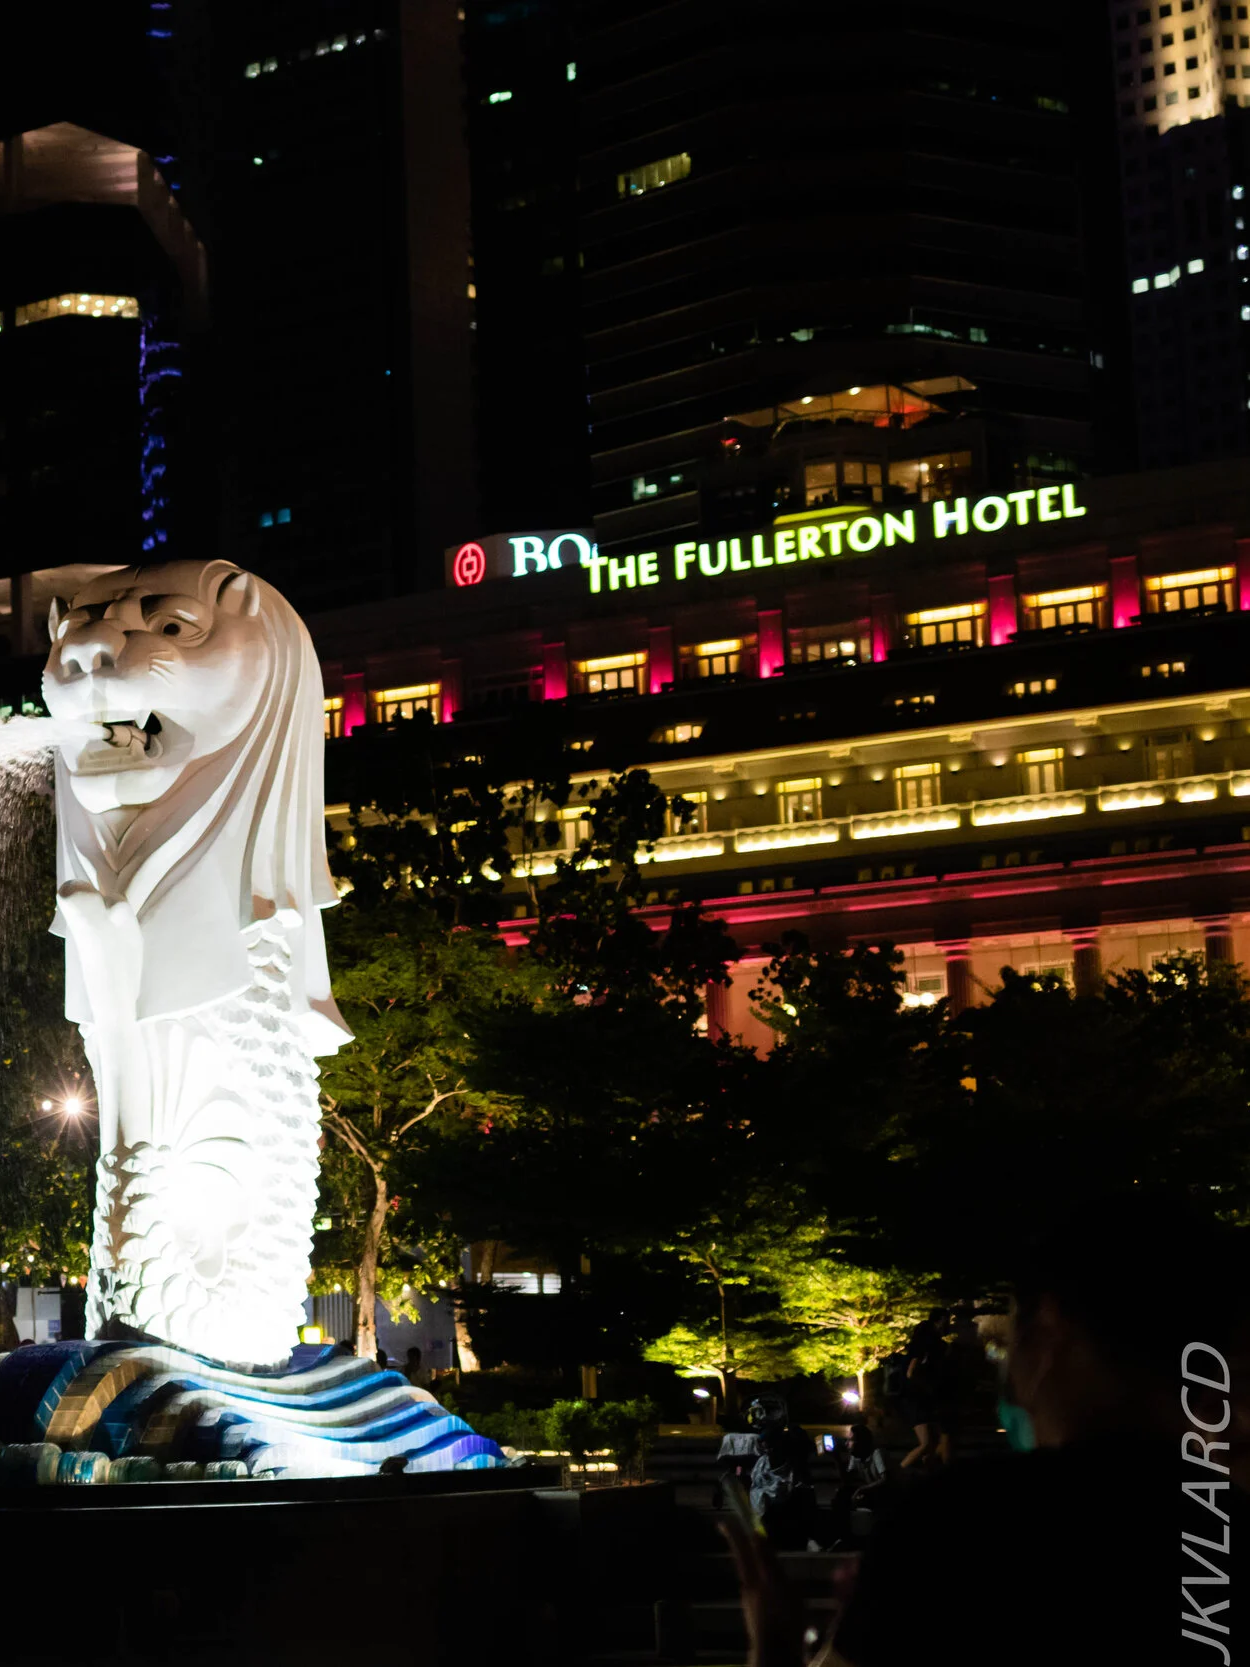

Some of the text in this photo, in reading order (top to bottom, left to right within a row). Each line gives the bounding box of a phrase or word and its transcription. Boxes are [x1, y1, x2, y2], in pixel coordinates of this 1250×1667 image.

[508, 533, 599, 577] BO
[581, 483, 1087, 594] THE FULLERTON HOTEL
